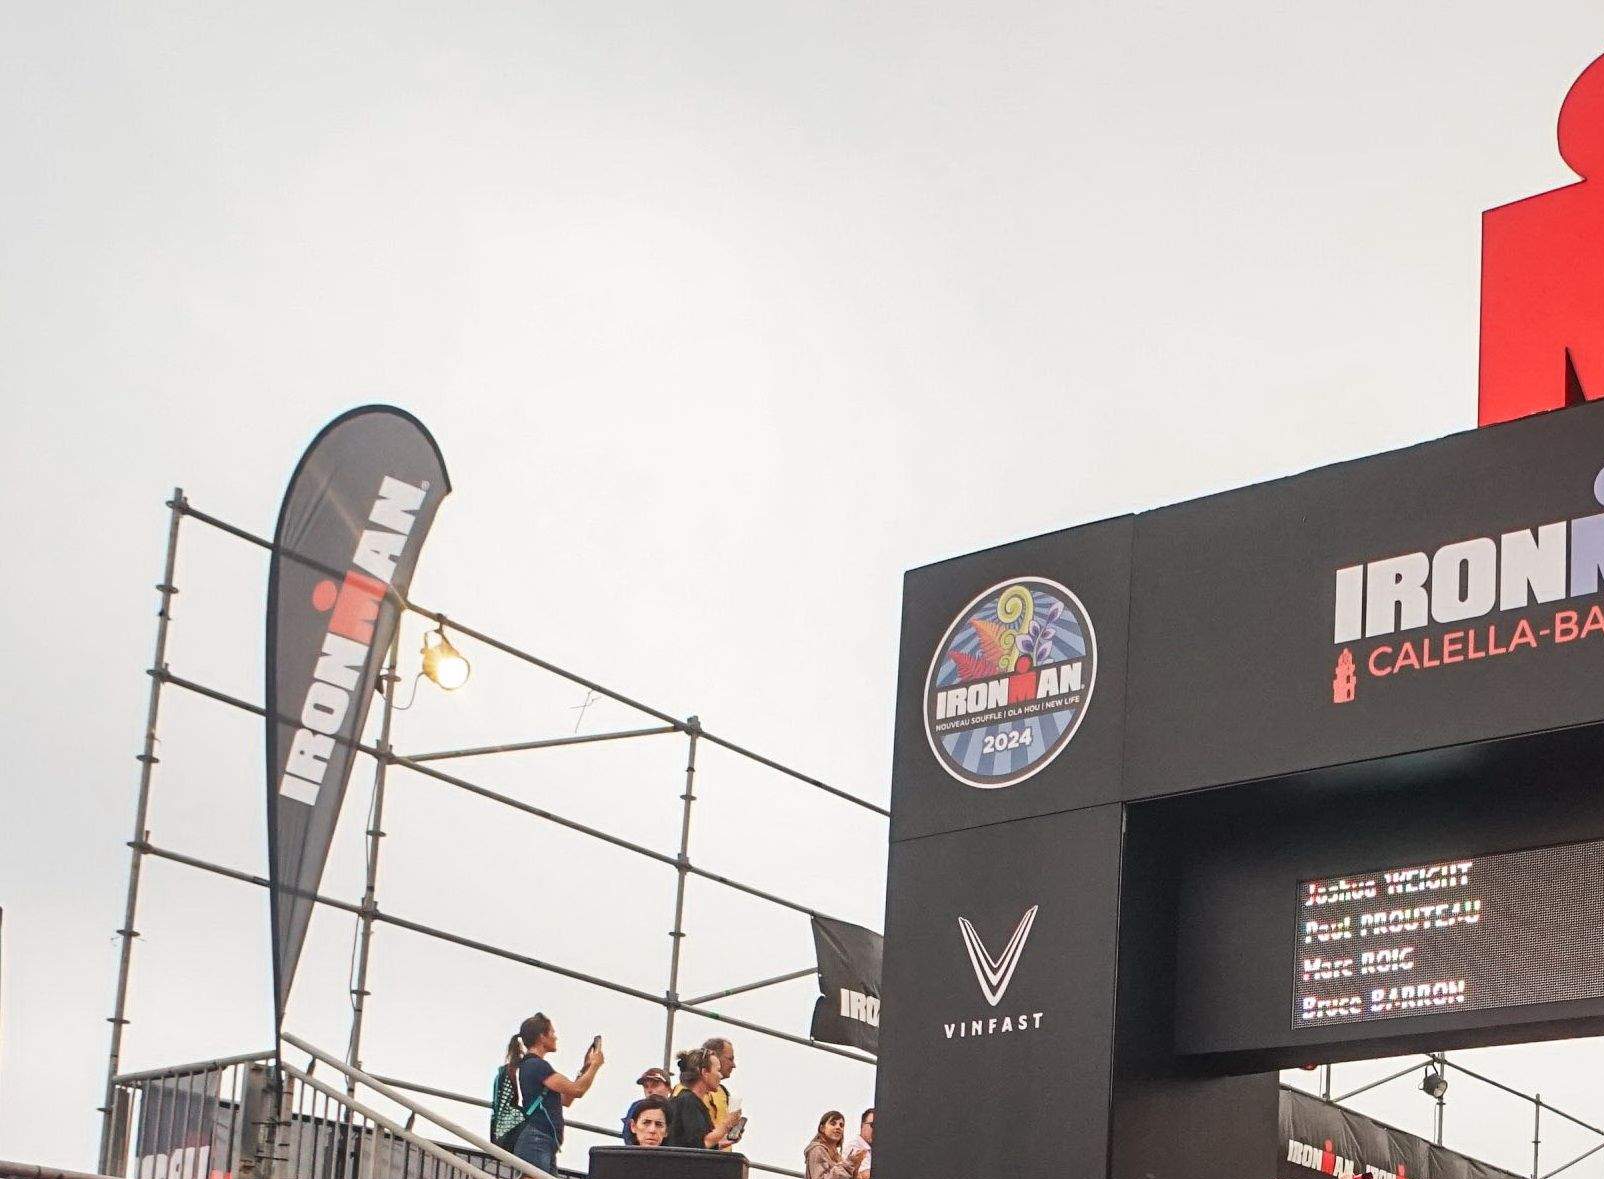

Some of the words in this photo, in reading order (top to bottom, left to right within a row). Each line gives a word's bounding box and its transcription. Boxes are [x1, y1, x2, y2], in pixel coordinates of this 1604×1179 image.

[278, 474, 427, 807] IRONMAN
[936, 655, 1082, 720] IRONMAN
[935, 719, 970, 732] NOUVEAU
[971, 711, 1002, 725] SOUFFLE
[1008, 709, 1023, 718] OLA
[1024, 704, 1041, 714] HOU
[1045, 699, 1063, 709] NEW
[1064, 695, 1081, 705] LIFE
[982, 728, 1032, 754] 2024
[944, 1013, 1043, 1039] VINFAST
